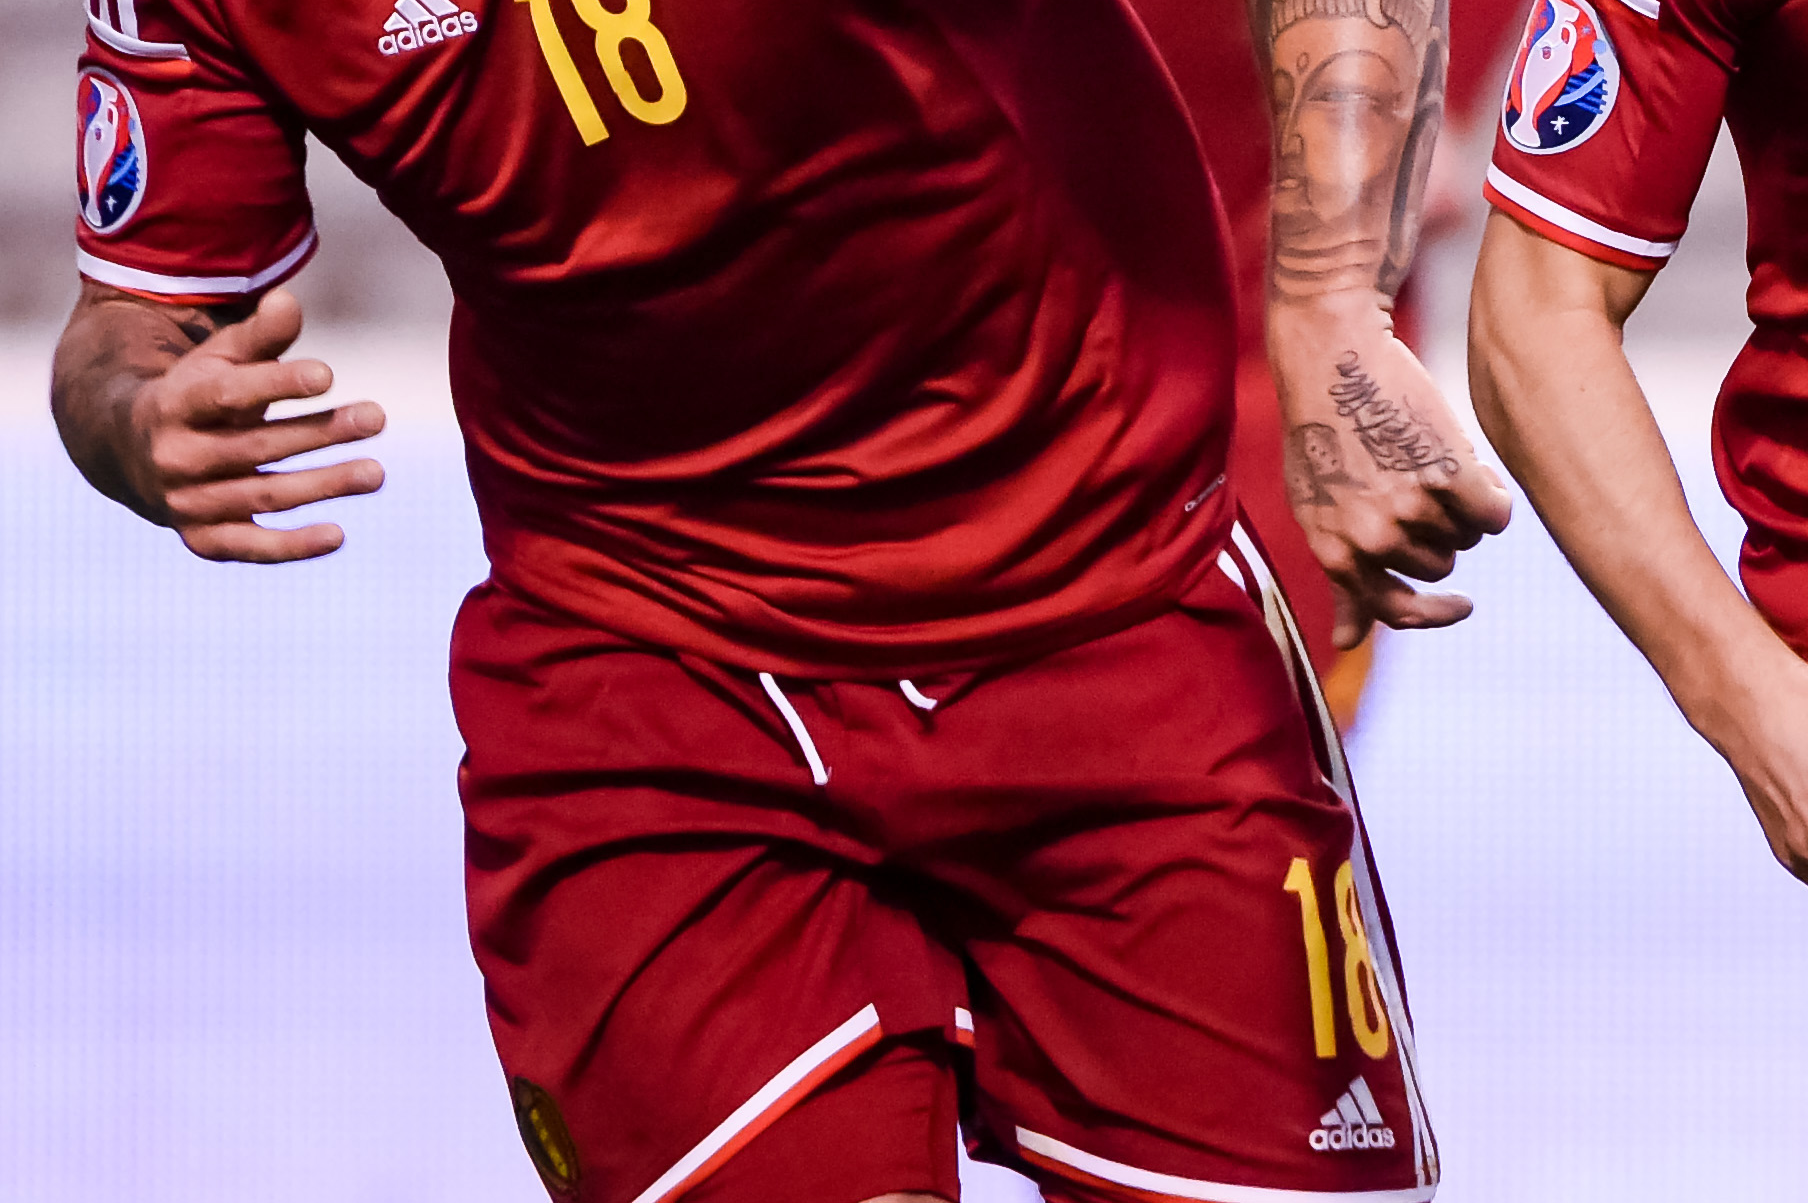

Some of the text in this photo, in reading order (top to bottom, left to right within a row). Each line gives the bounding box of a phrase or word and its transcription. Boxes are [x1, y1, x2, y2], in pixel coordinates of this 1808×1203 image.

[378, 10, 479, 56] adidas
[1283, 856, 1390, 1060] 18
[1308, 1121, 1396, 1152] adidas
